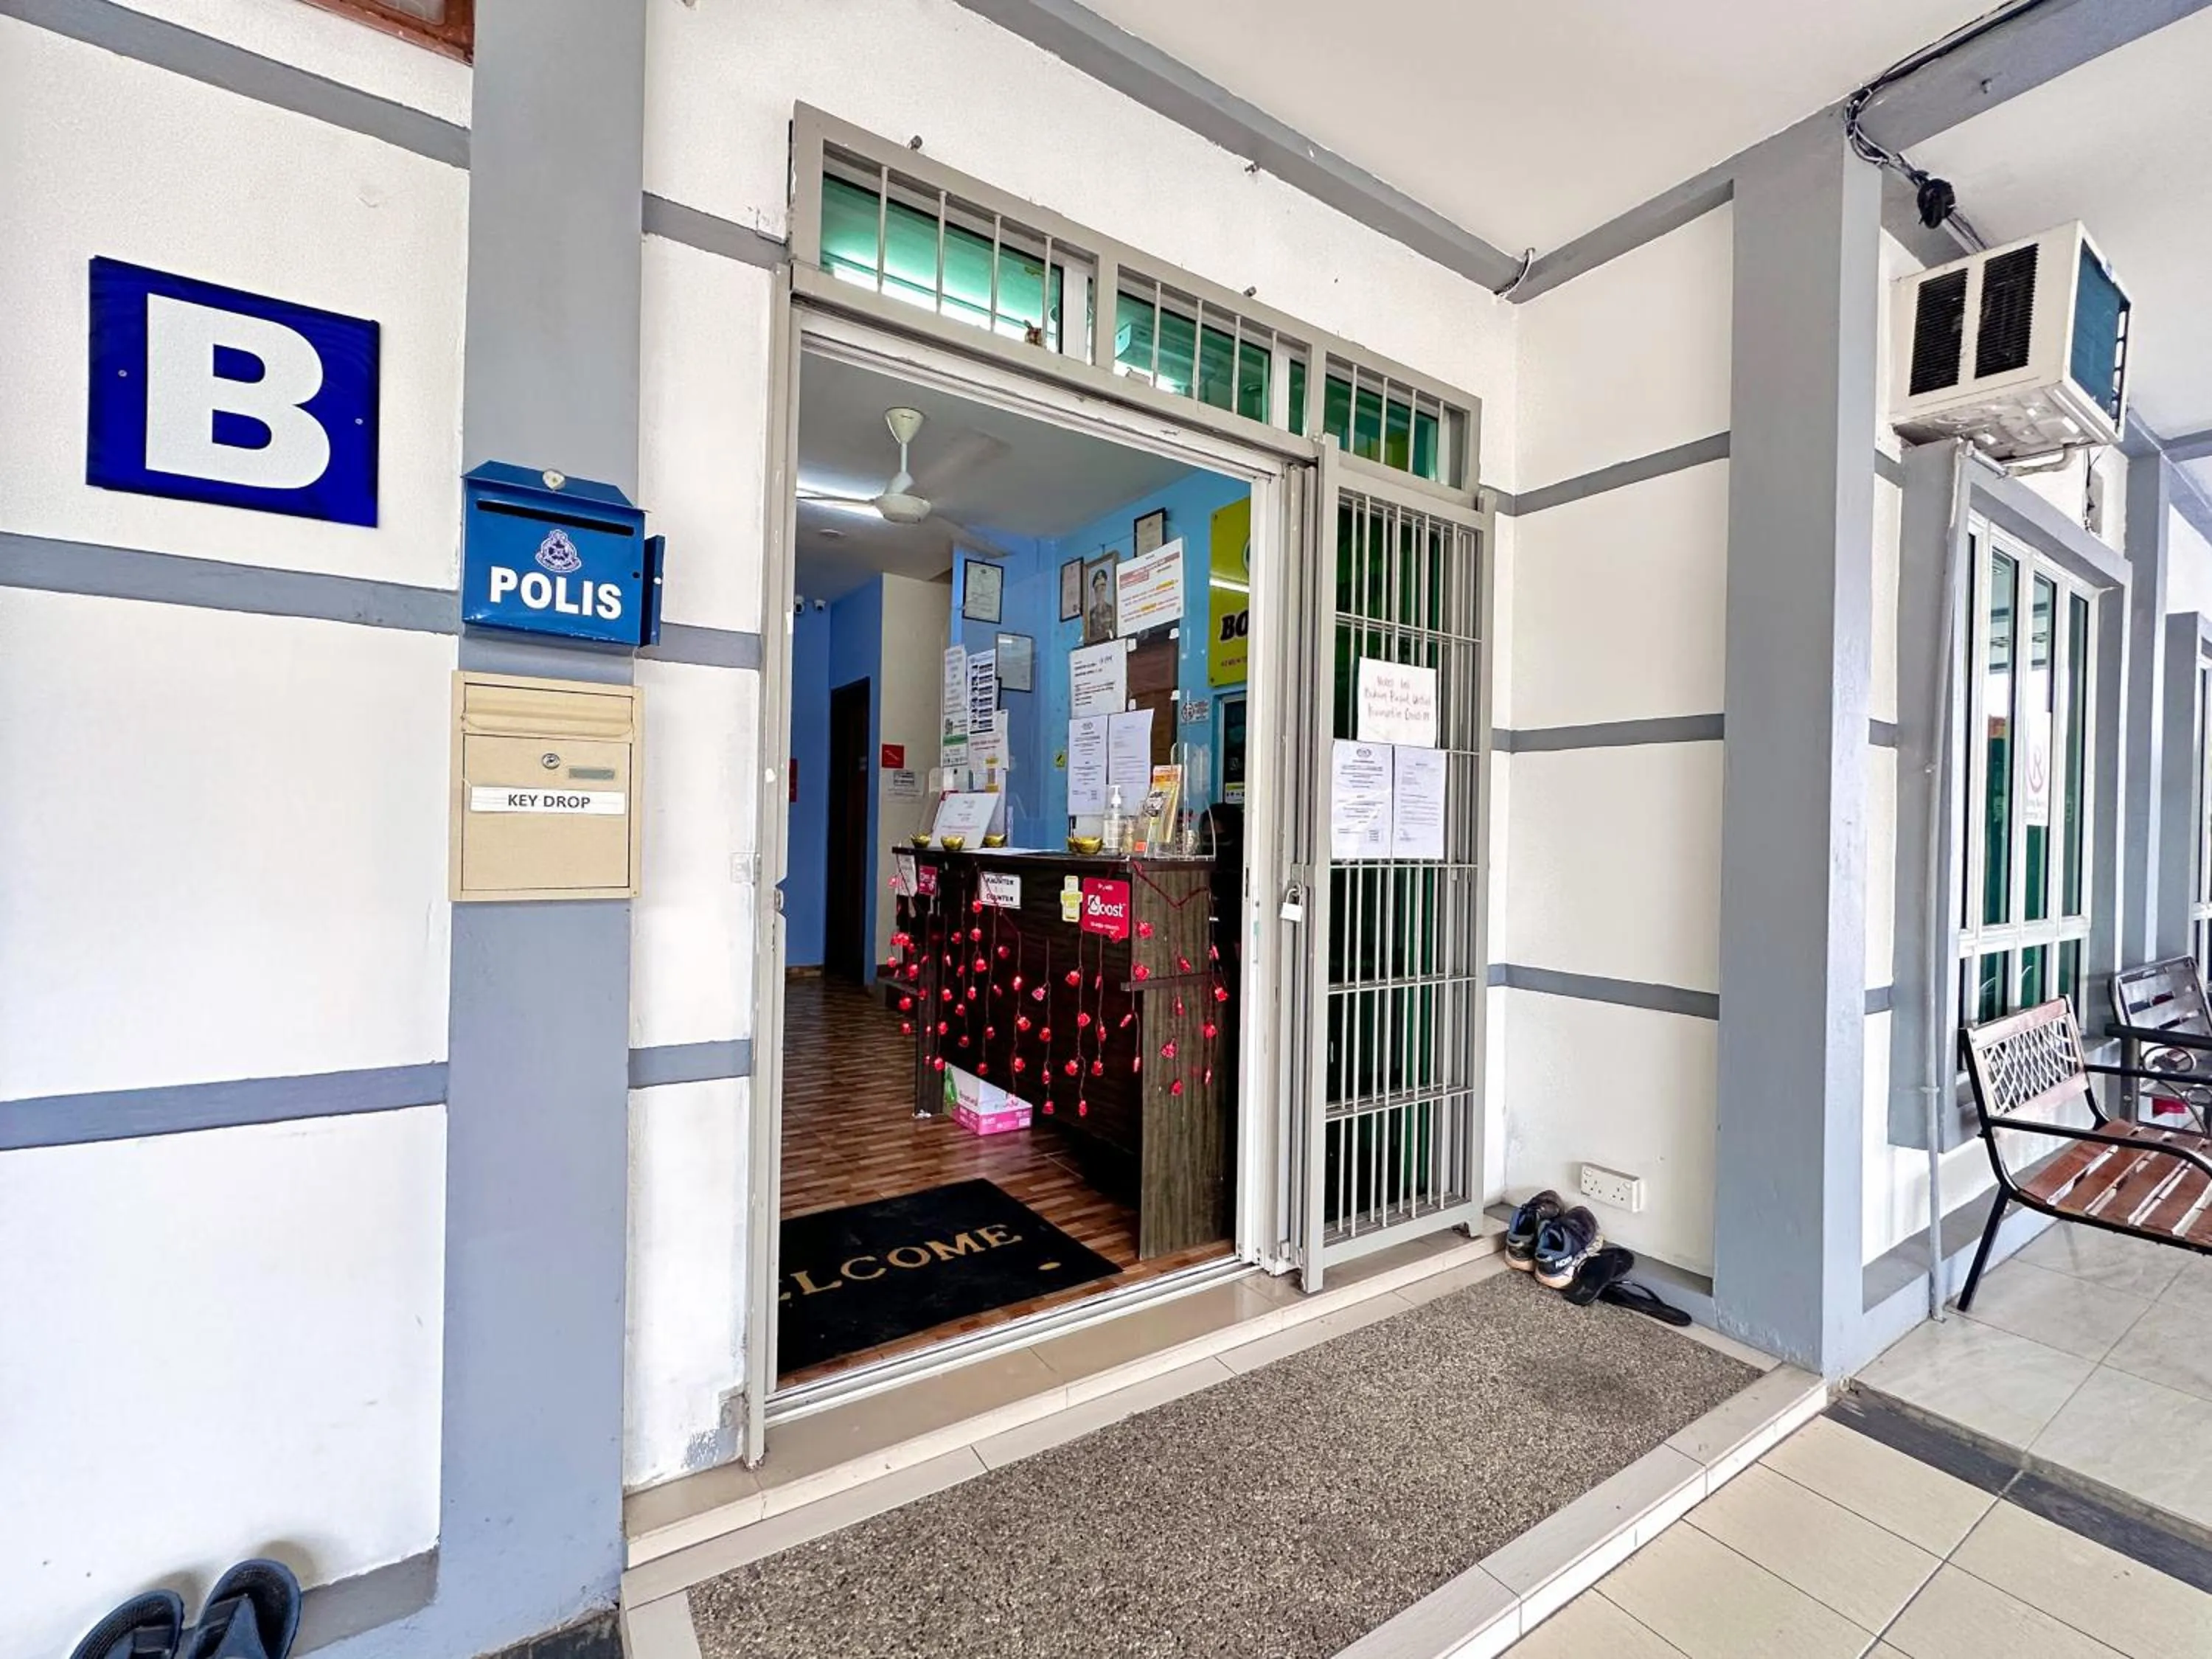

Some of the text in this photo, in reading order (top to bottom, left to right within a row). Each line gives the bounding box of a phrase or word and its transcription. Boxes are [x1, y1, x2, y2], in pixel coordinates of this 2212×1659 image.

[145, 292, 331, 490] B
[490, 566, 622, 620] POLIS
[507, 793, 591, 809] KEY DROP
